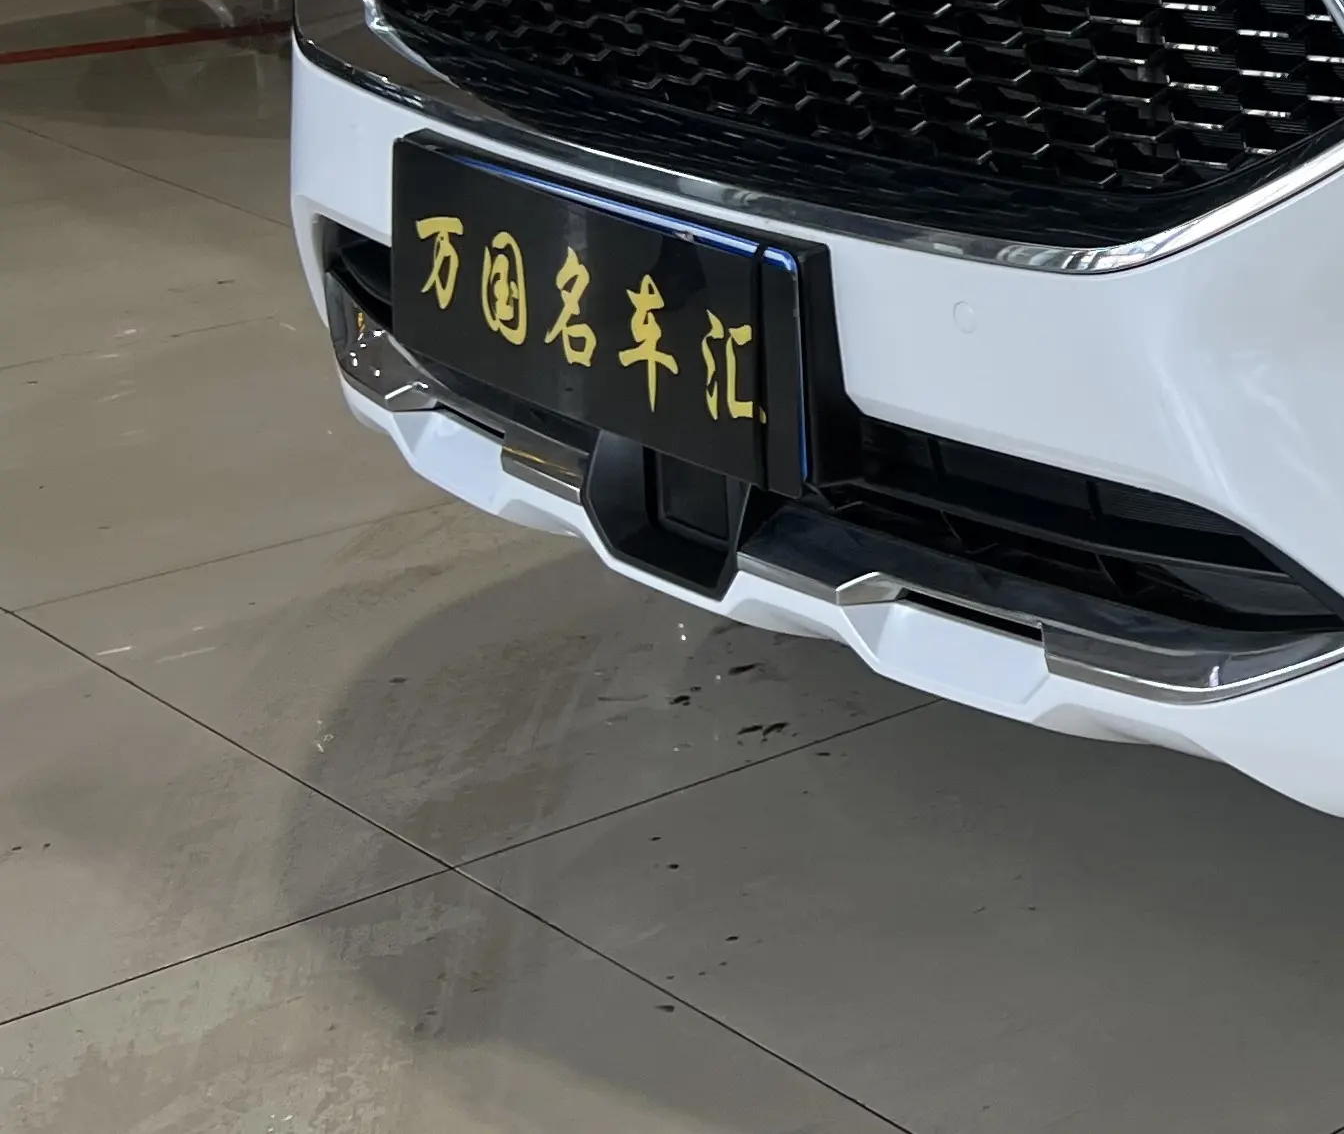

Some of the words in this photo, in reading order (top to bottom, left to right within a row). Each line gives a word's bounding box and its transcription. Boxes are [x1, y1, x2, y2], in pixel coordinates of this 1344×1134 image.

[415, 216, 767, 424] 万国名车汇
